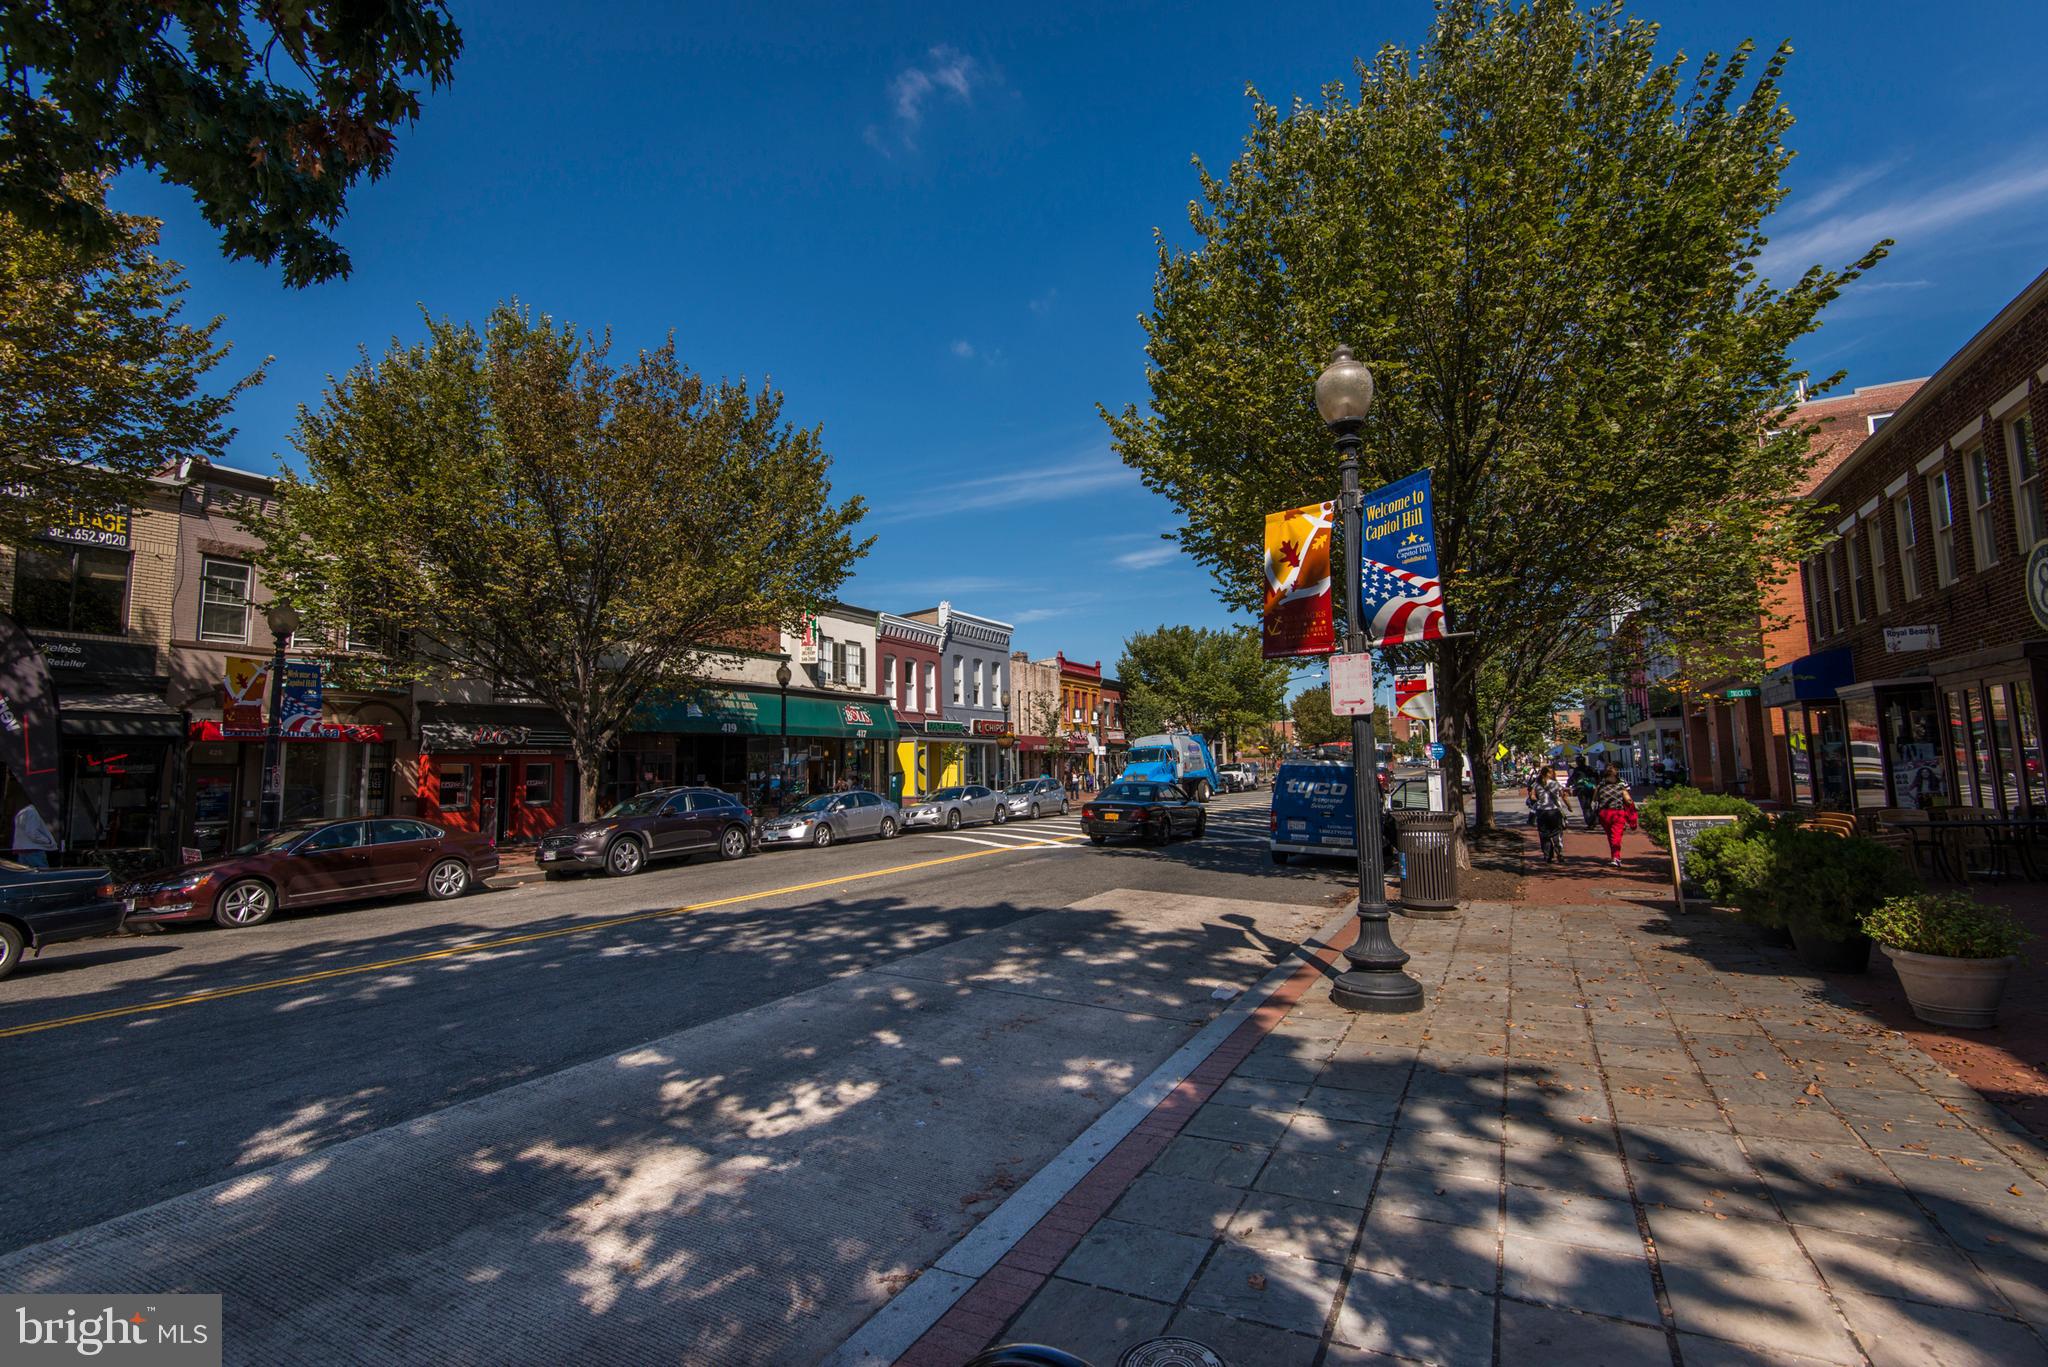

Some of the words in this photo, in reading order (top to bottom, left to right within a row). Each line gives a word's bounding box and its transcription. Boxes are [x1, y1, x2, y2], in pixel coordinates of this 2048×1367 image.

[1366, 495, 1410, 522] Welcome
[1413, 489, 1424, 505] to
[1365, 515, 1400, 541] Capitol
[1402, 507, 1423, 529] Hill
[1396, 546, 1418, 559] Capitol
[1419, 545, 1432, 554] Hill
[1886, 628, 1907, 638] Royal
[1908, 626, 1935, 636] Beauty
[47, 658, 86, 668] Retailer
[721, 723, 737, 733] 419
[856, 729, 867, 738] 417
[1286, 778, 1348, 799] tyco
